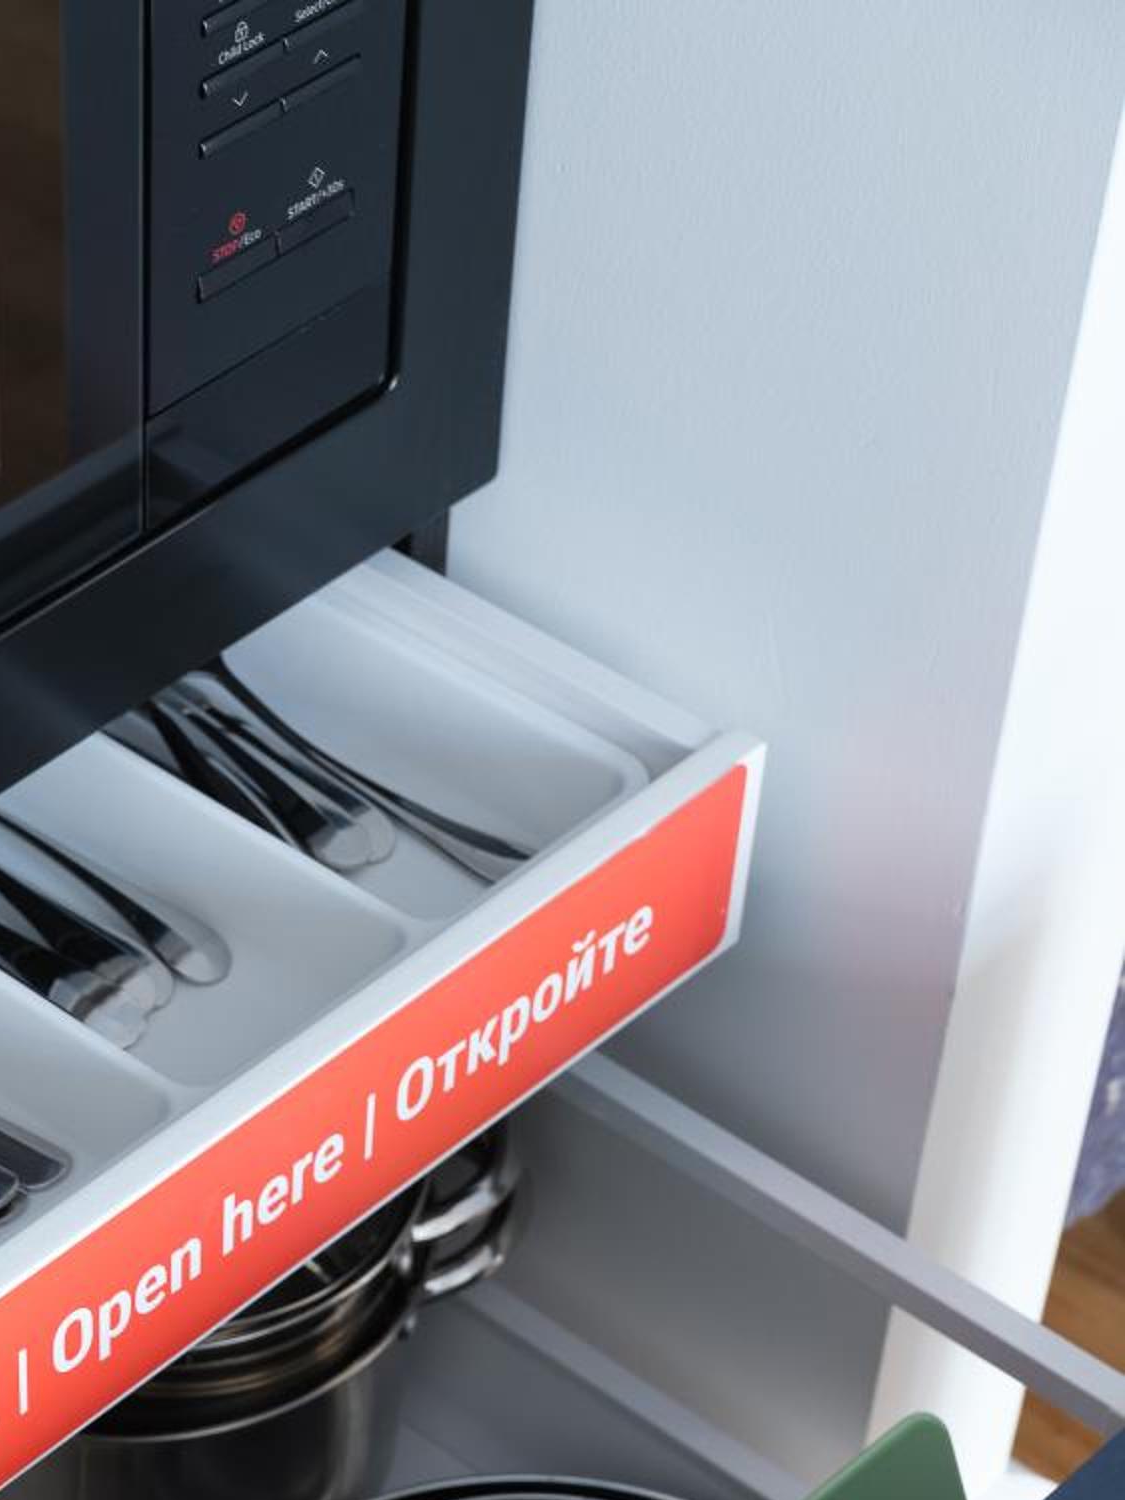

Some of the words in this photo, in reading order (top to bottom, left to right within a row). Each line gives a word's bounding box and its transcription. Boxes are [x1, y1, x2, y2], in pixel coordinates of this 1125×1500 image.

[52, 1237, 203, 1373] Open
[222, 1133, 345, 1255] here
[395, 904, 654, 1121] Откройте
